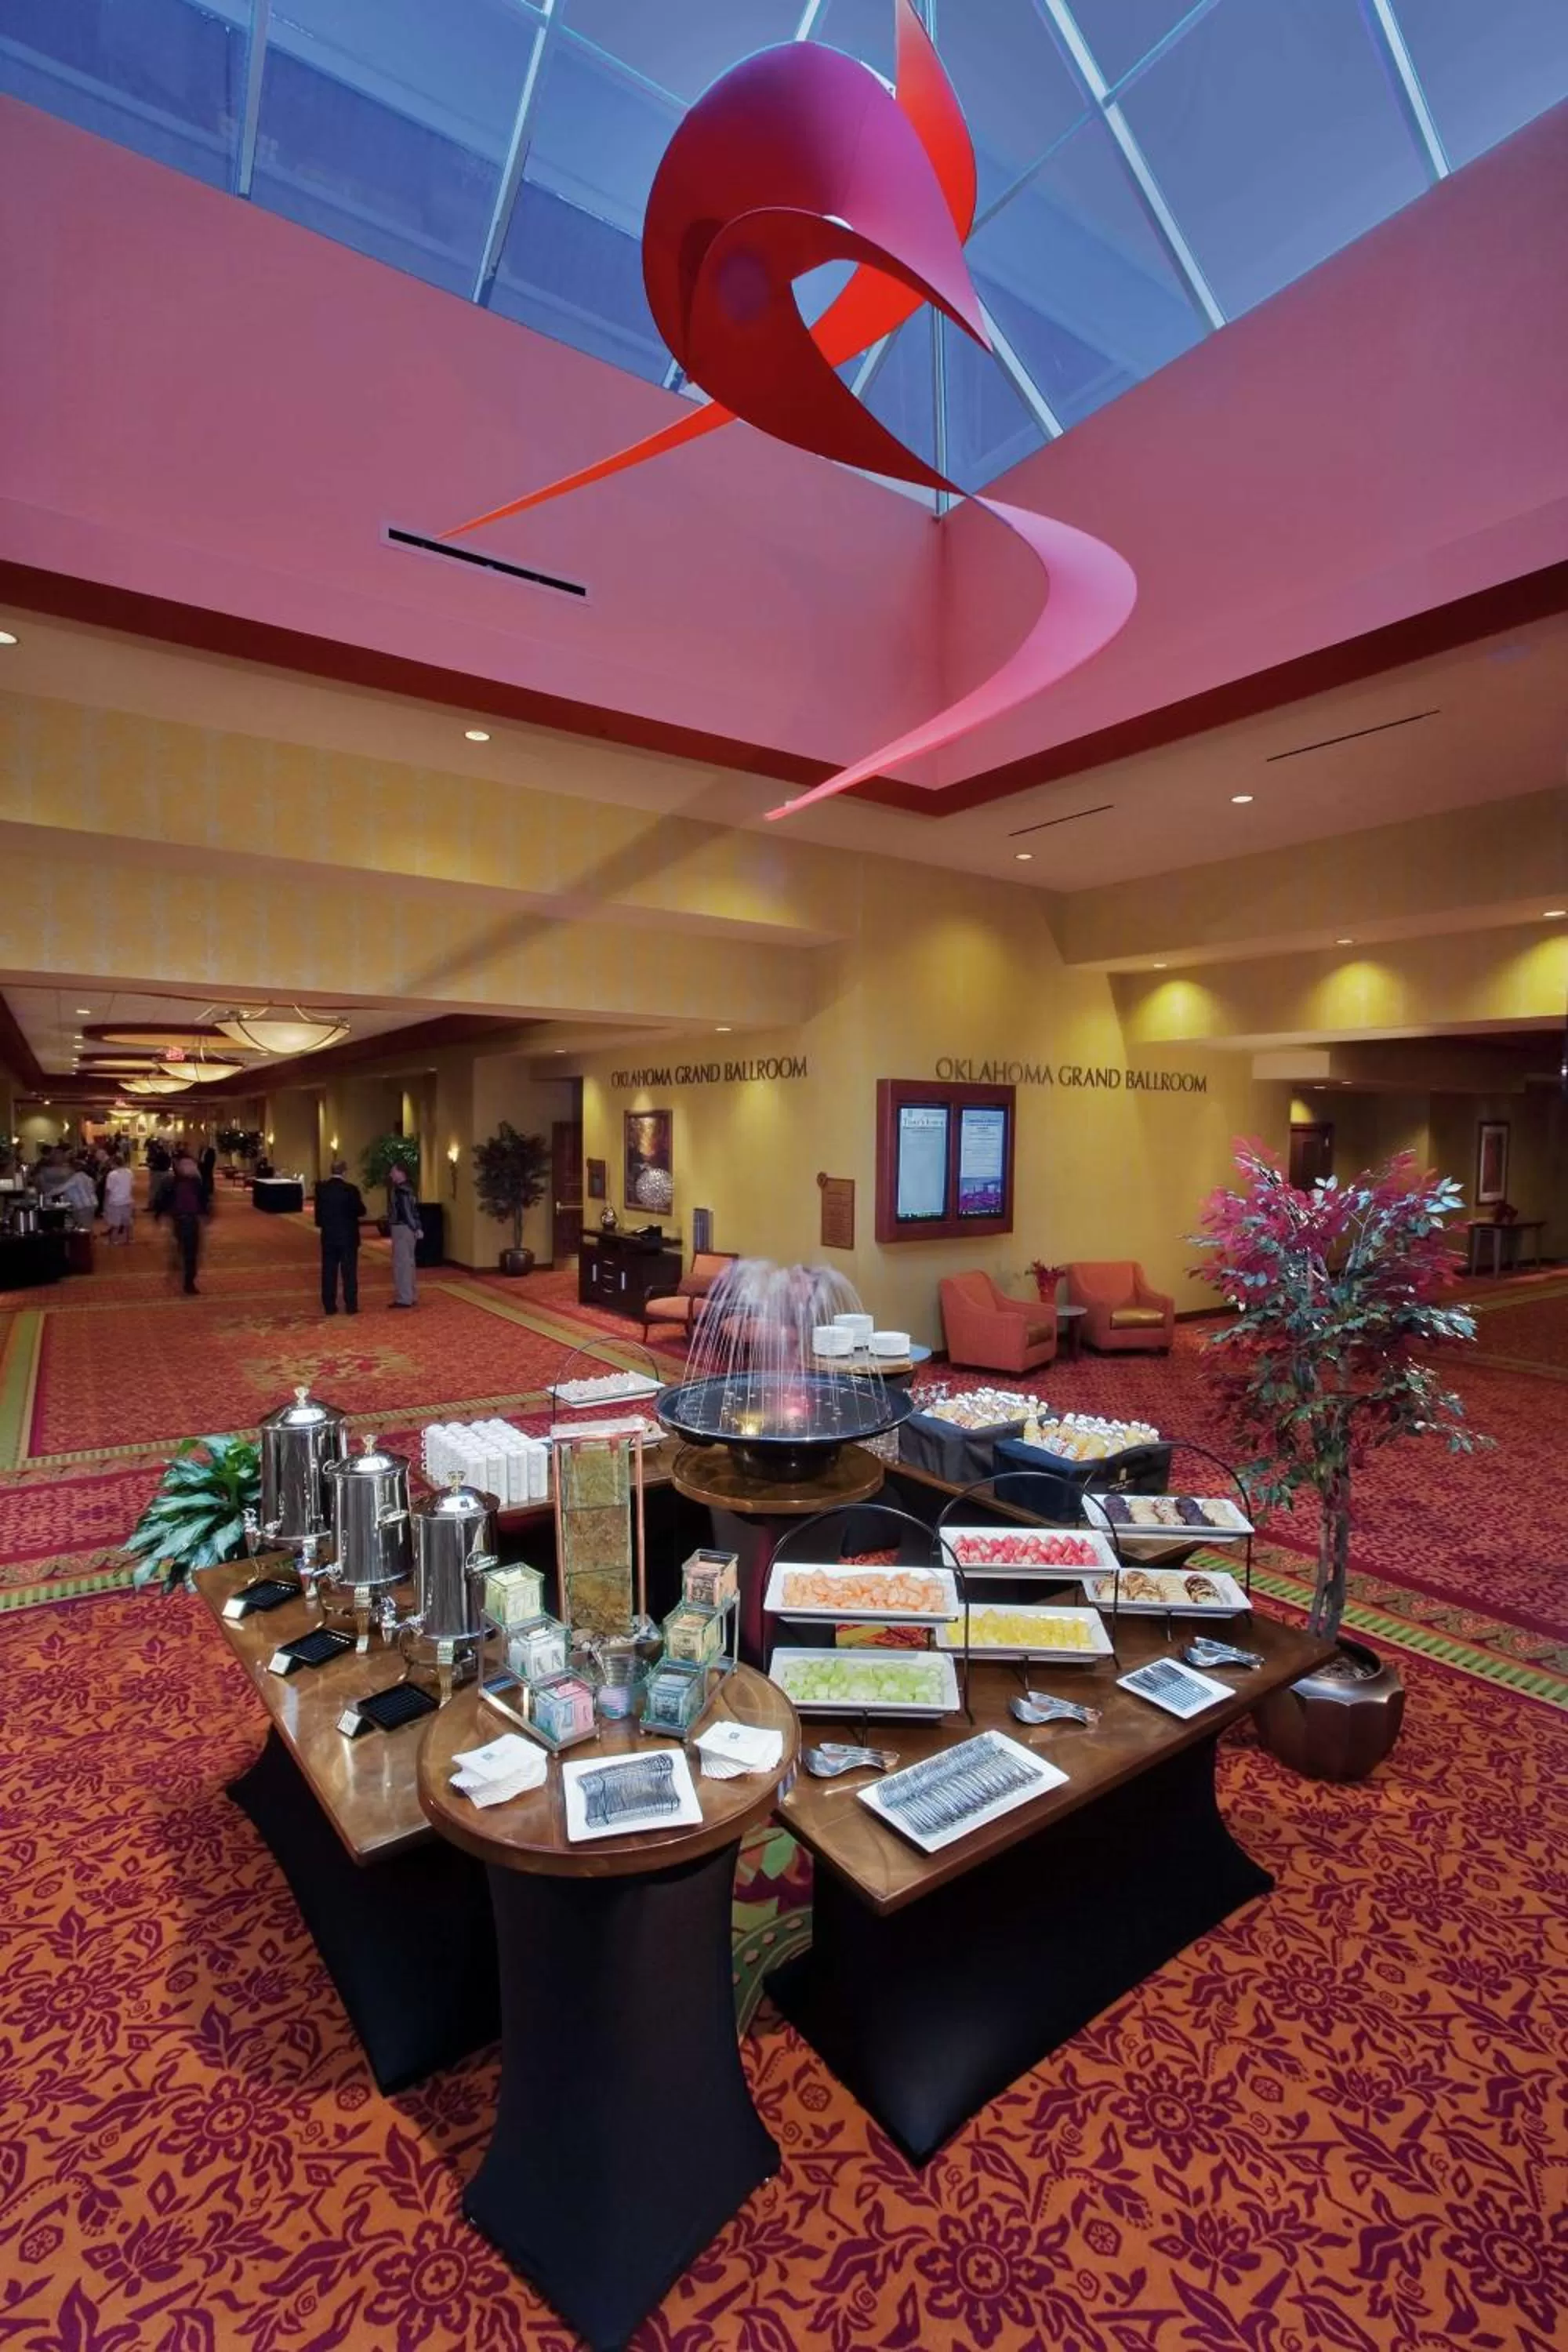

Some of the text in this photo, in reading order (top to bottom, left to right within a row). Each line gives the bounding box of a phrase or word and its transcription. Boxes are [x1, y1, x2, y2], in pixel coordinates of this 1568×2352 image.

[611, 1056, 808, 1088] OKLAHOMA GRAND BALLROOM
[935, 1057, 1207, 1093] OKLAHOMA GRAND BALLROOM
